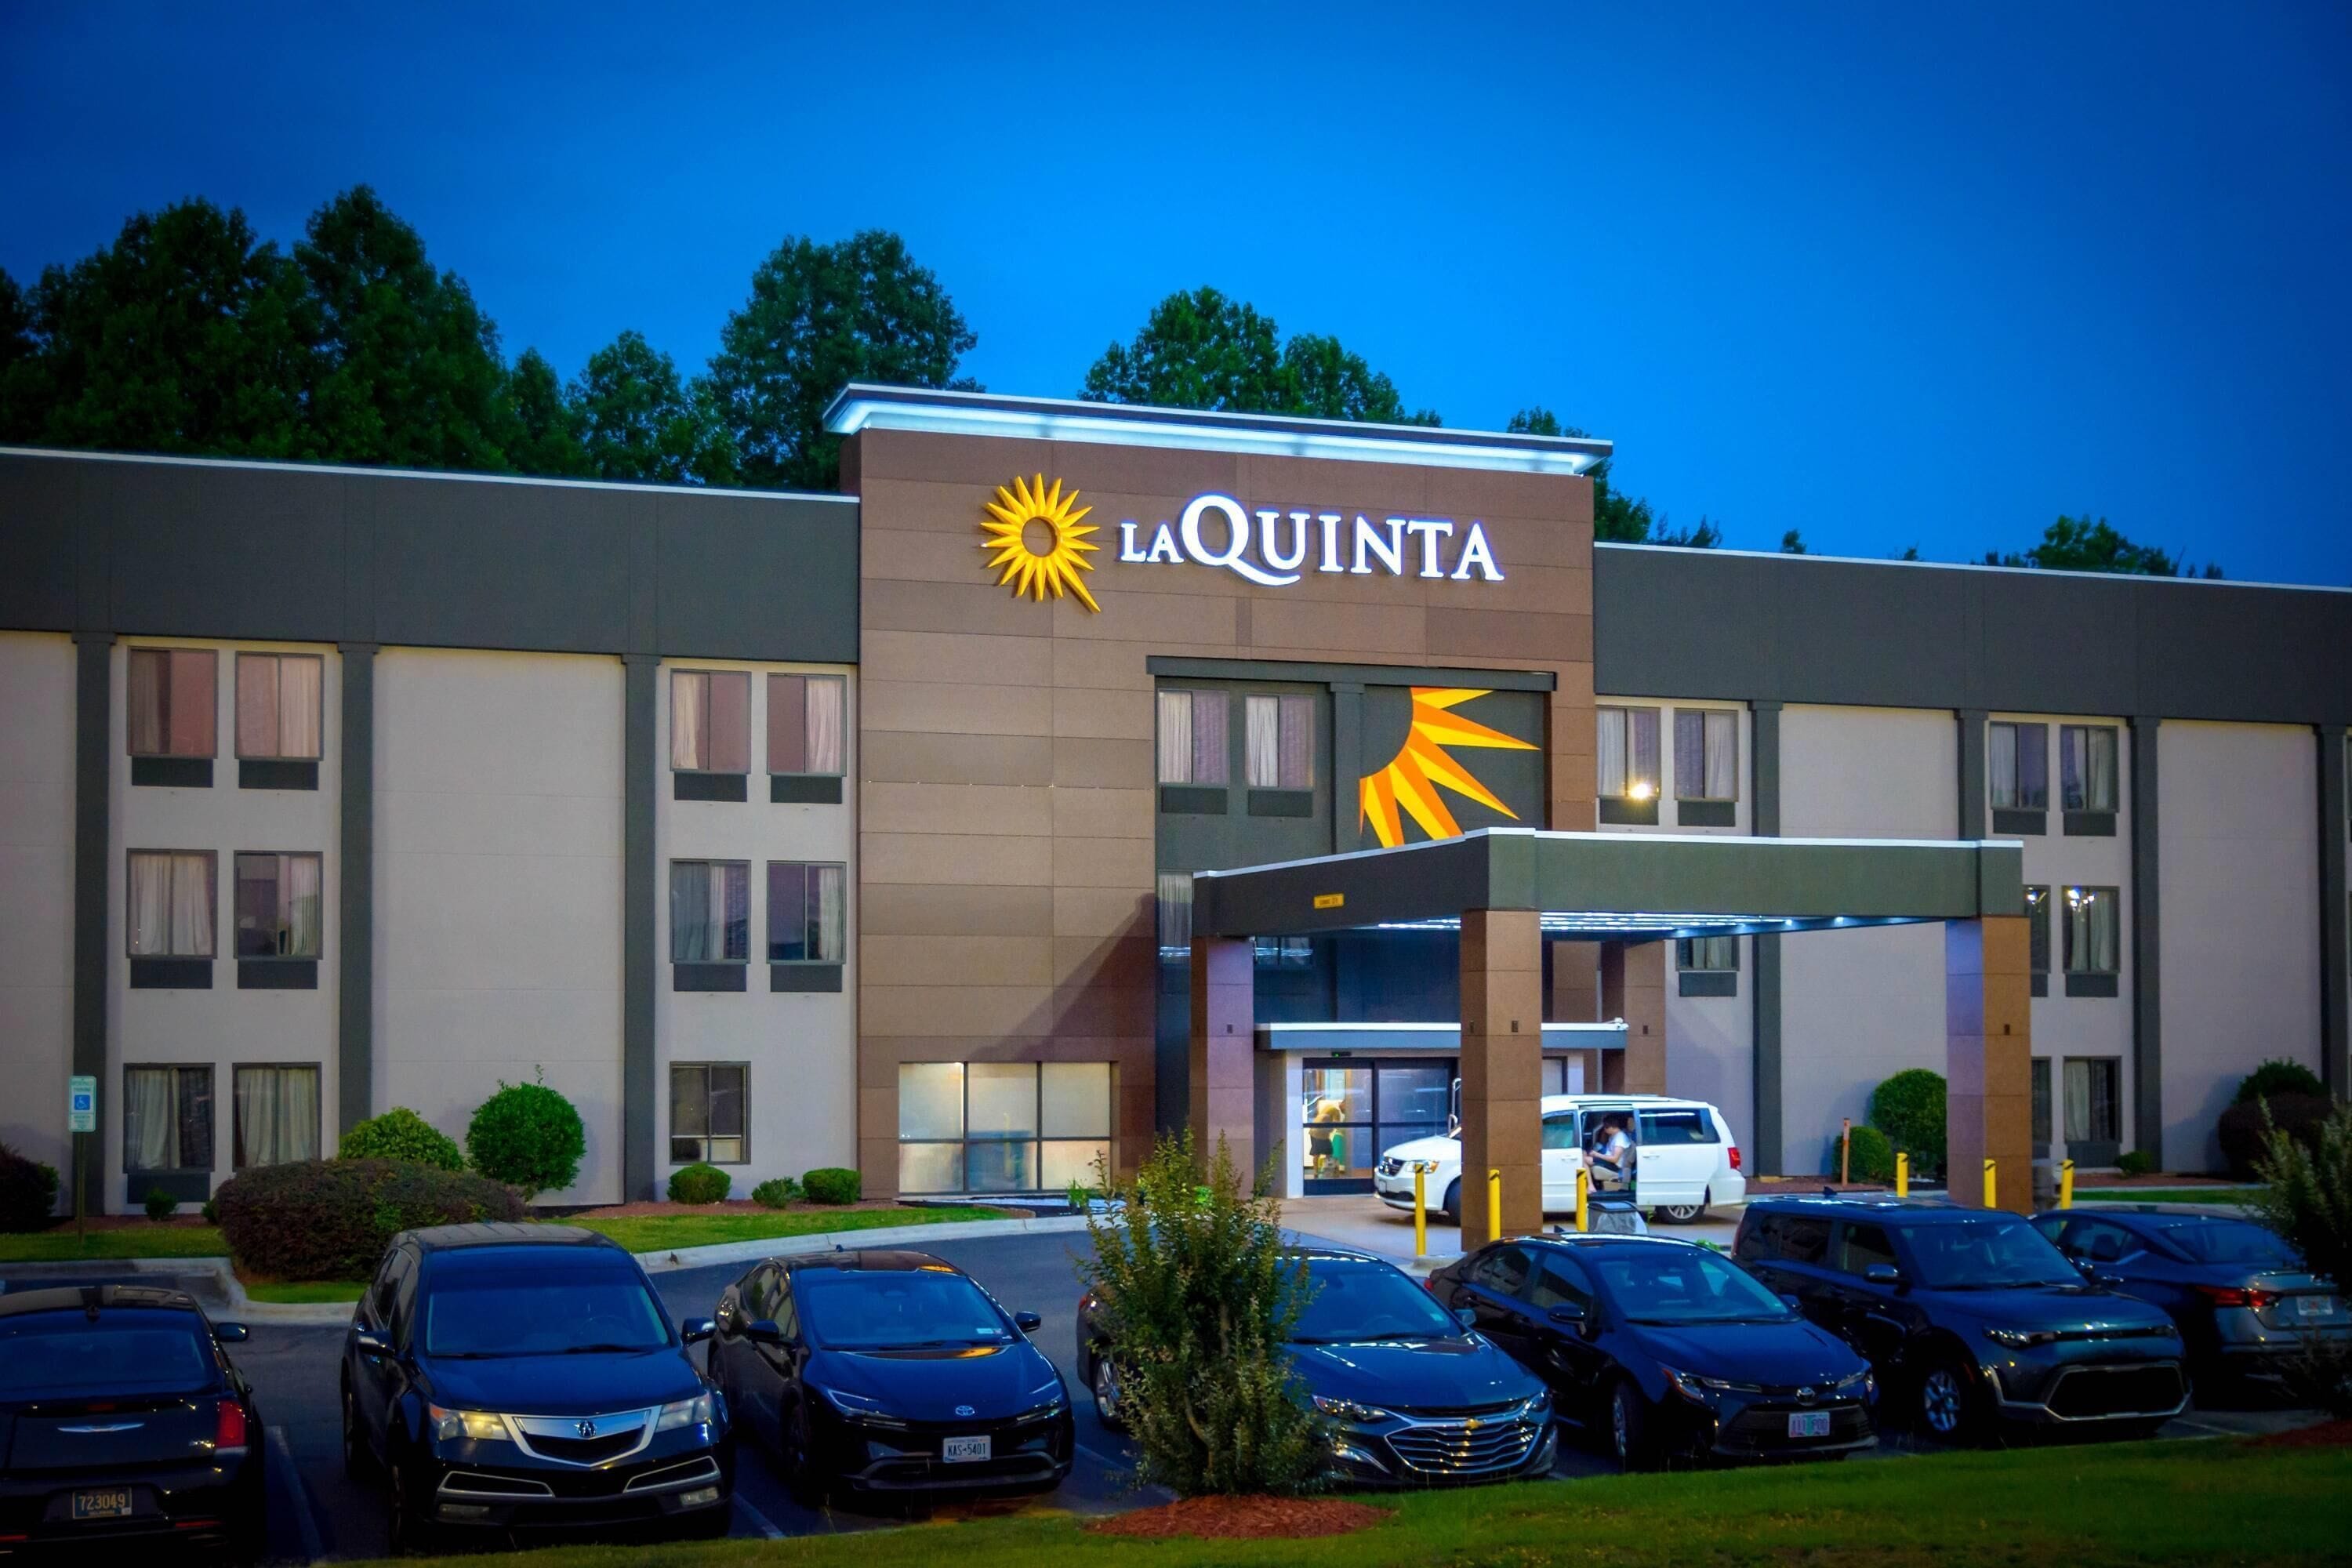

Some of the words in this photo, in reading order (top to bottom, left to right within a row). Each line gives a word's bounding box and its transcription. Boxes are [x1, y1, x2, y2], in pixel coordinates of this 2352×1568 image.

[1120, 522, 1185, 563] LA
[1180, 493, 1505, 586] QUINTA
[78, 1493, 126, 1512] 723049
